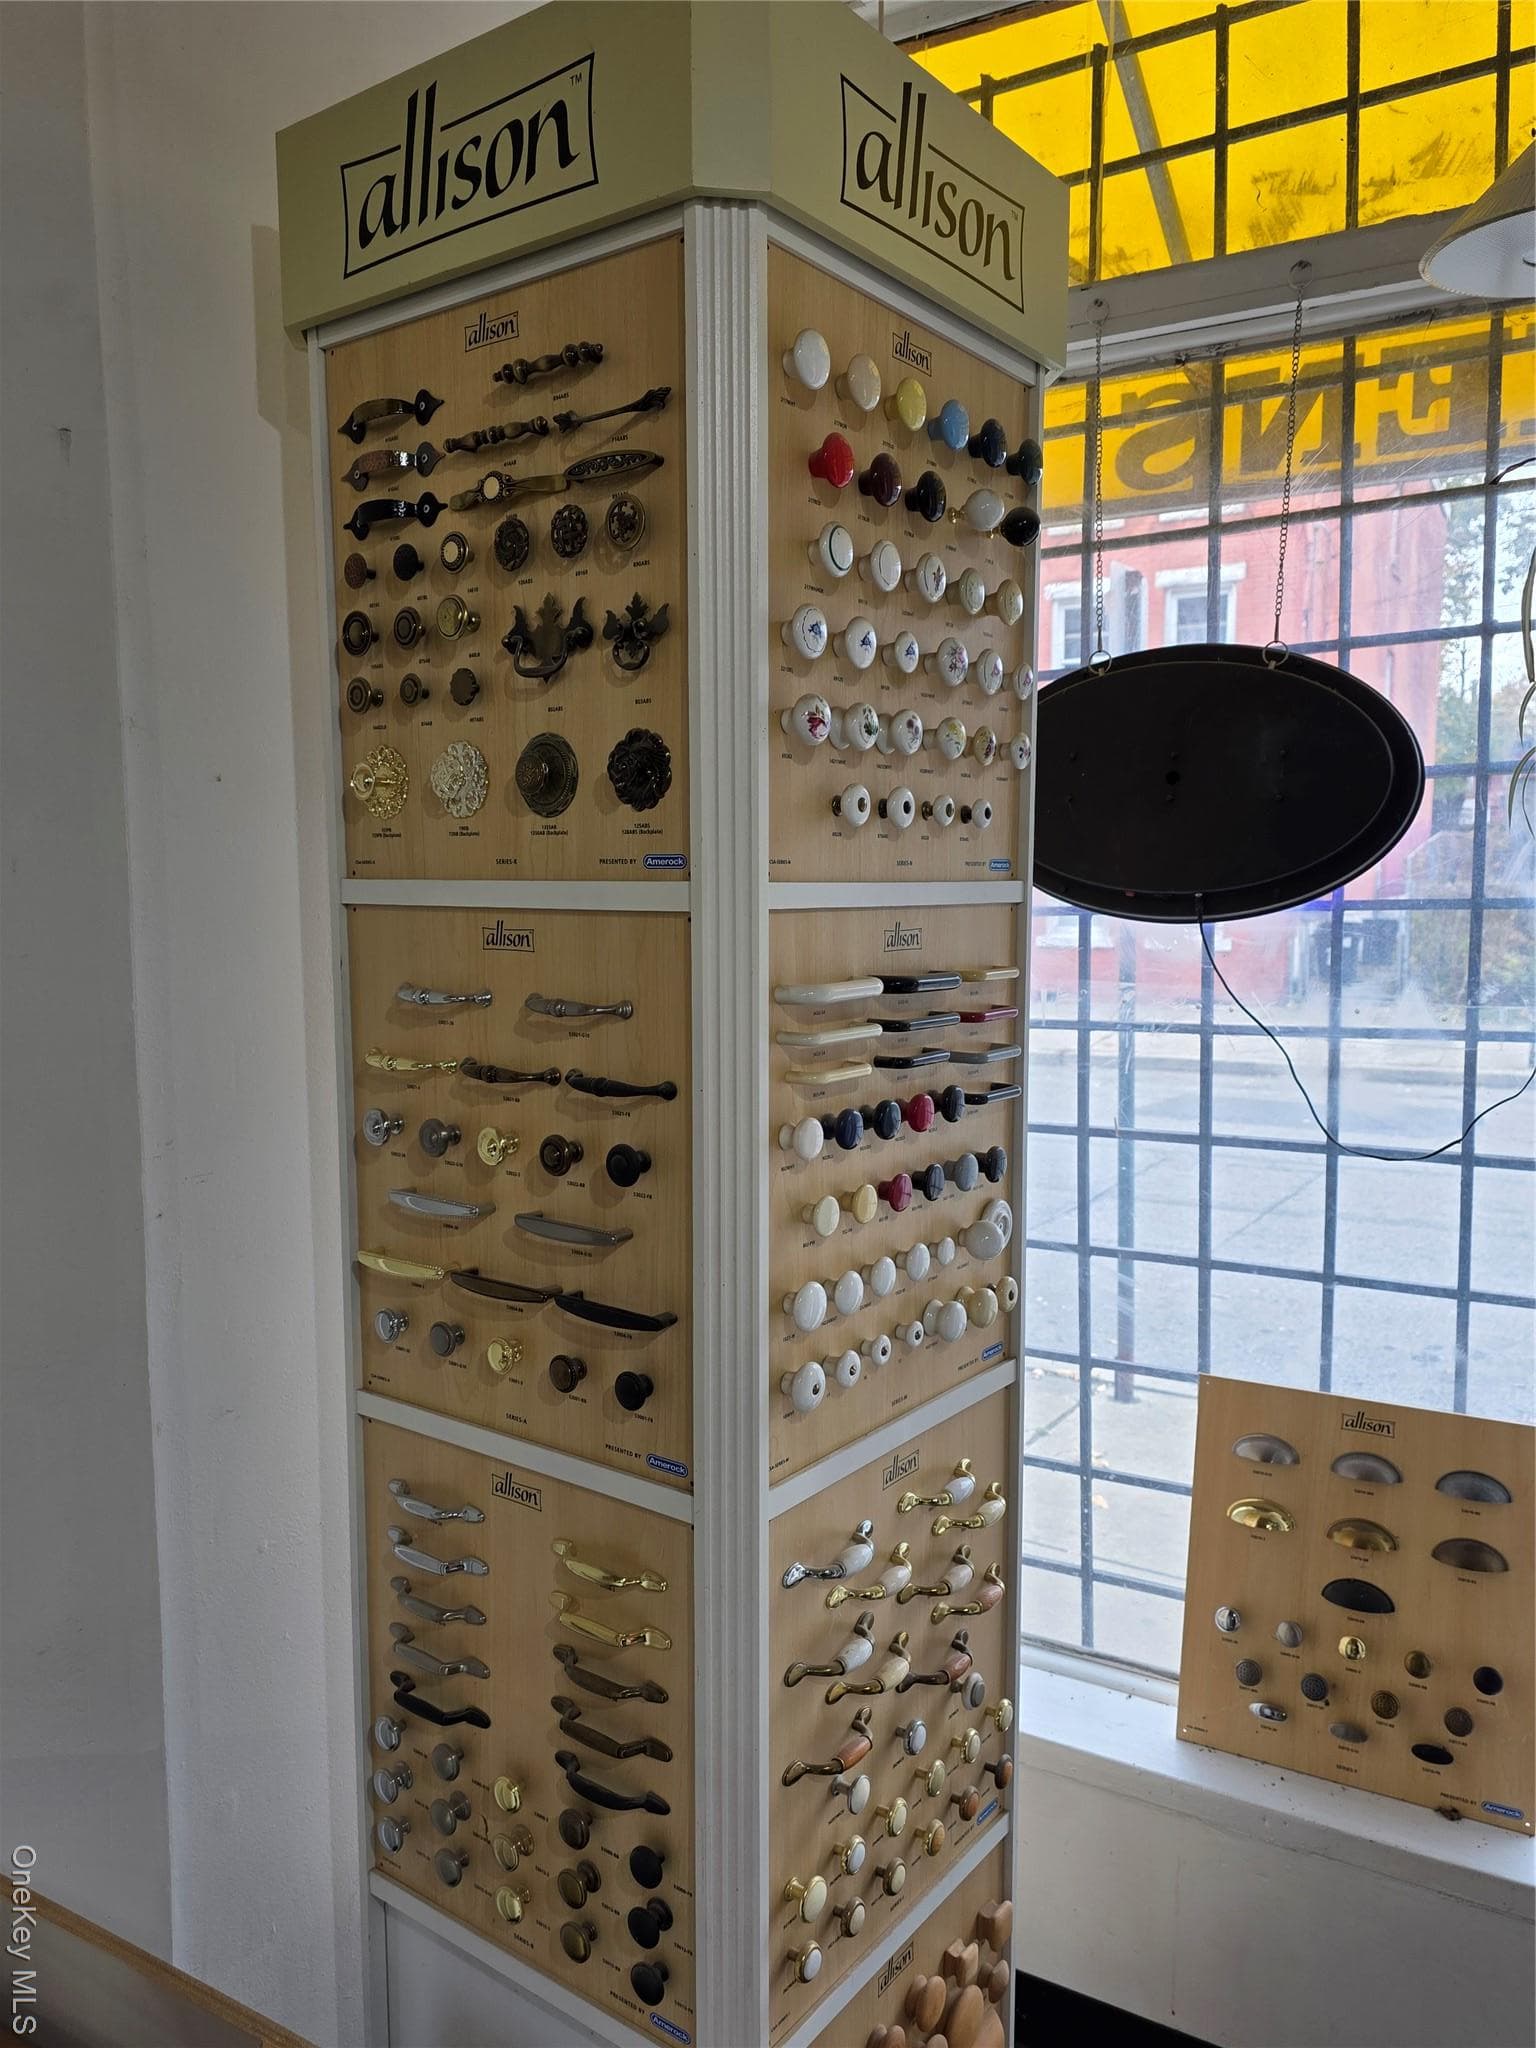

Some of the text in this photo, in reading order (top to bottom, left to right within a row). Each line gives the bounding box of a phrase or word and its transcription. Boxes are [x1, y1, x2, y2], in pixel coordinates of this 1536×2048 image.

[359, 81, 581, 249] allison
[856, 82, 1015, 280] allison
[468, 312, 516, 348] allison
[893, 330, 930, 370] allison
[646, 857, 684, 867] Amerock
[485, 920, 532, 948] allison
[886, 921, 920, 948] allison
[1344, 1409, 1392, 1436] allison
[604, 1443, 633, 1458] PRESENTED
[649, 1456, 685, 1475] Amerock
[885, 1455, 918, 1487] allison
[494, 1472, 539, 1506] allison
[1483, 1803, 1522, 1819] Amerock
[653, 2016, 688, 2041] Amerock
